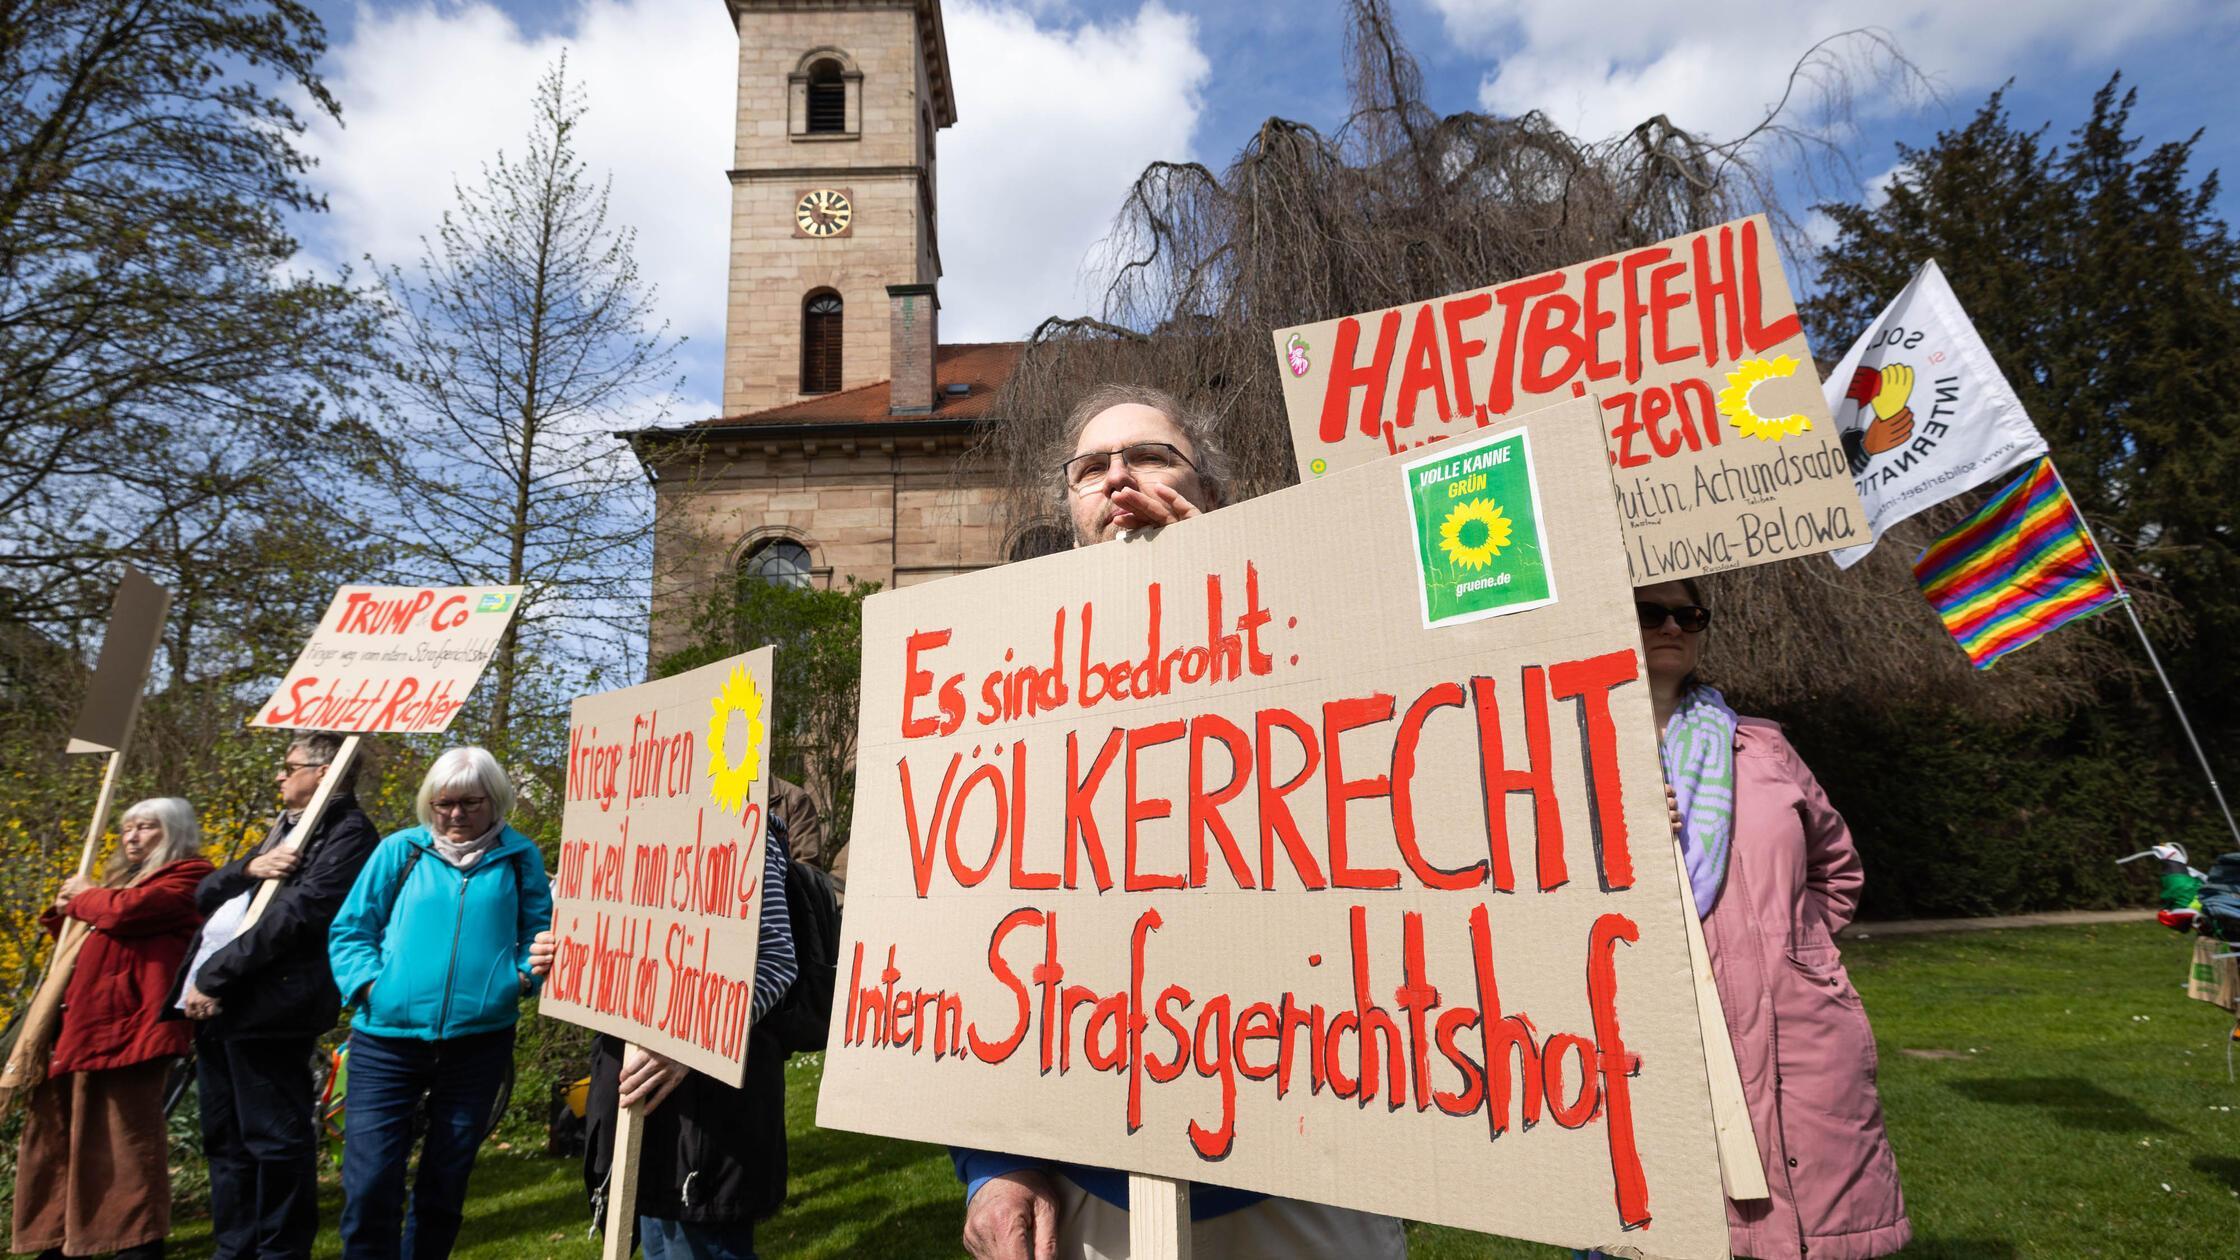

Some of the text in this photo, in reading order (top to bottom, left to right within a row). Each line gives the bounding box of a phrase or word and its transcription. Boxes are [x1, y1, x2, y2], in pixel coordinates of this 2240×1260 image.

[1319, 220, 1801, 444] HAFTBEFEHL
[1420, 446, 1511, 487] VOLLE KANNE
[1448, 473, 1487, 498] GRÜN
[336, 590, 435, 635] TRUMP
[430, 595, 469, 632] Co
[1456, 572, 1511, 597] gruene.de
[367, 677, 463, 733] Richter
[902, 628, 967, 739] Es
[976, 606, 1068, 726] sind
[568, 710, 694, 812] Kriege führen
[897, 649, 1638, 899] VÖLKERRECHT
[558, 838, 590, 899] nur
[592, 815, 629, 903] weil
[631, 842, 669, 909] man
[586, 911, 637, 1019] Macht
[632, 918, 659, 1028] den
[657, 922, 749, 1064] Stärkeren
[843, 902, 1653, 1231] Intern. Strafsgerichtshof
